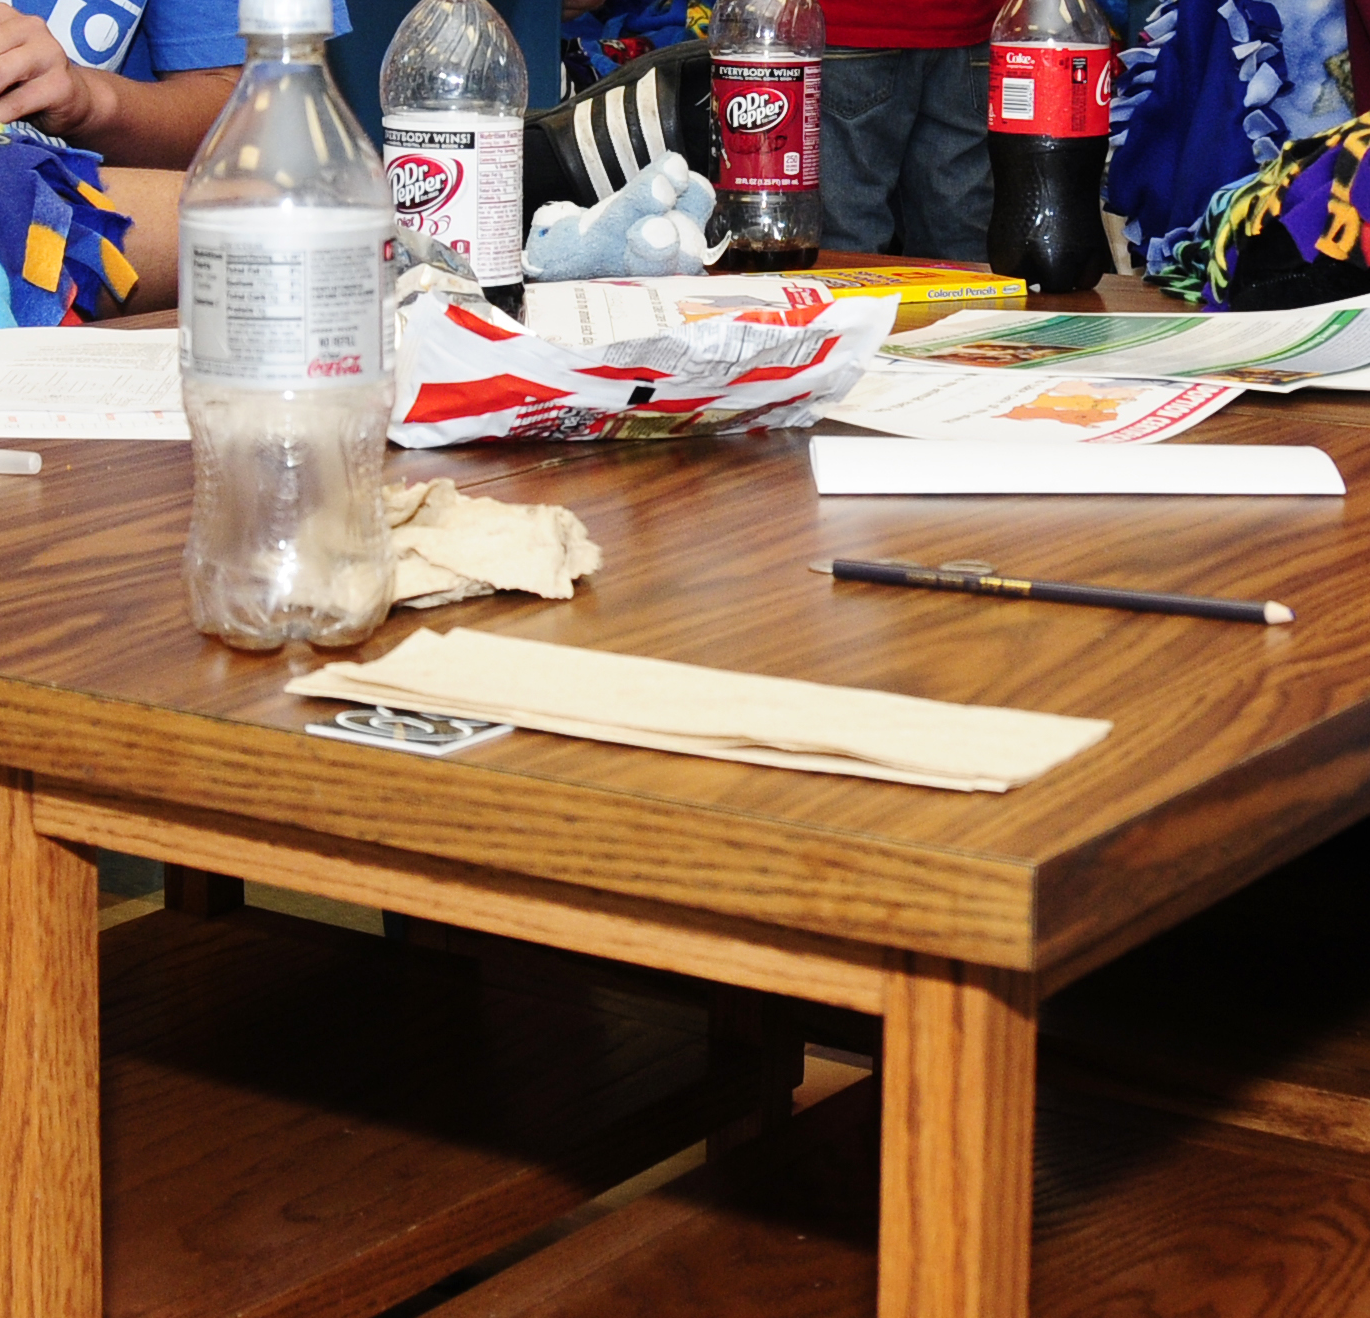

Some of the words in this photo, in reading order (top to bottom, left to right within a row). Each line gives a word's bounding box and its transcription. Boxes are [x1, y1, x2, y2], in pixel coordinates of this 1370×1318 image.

[1006, 52, 1031, 64] Coke
[773, 68, 801, 77] WINS!
[731, 96, 784, 128] Pepper
[746, 92, 769, 113] Dr
[433, 133, 471, 144] WINS!
[403, 162, 428, 186] Dr
[392, 167, 447, 207] Pepper
[927, 278, 963, 299] Colored
[965, 276, 997, 296] Pencils
